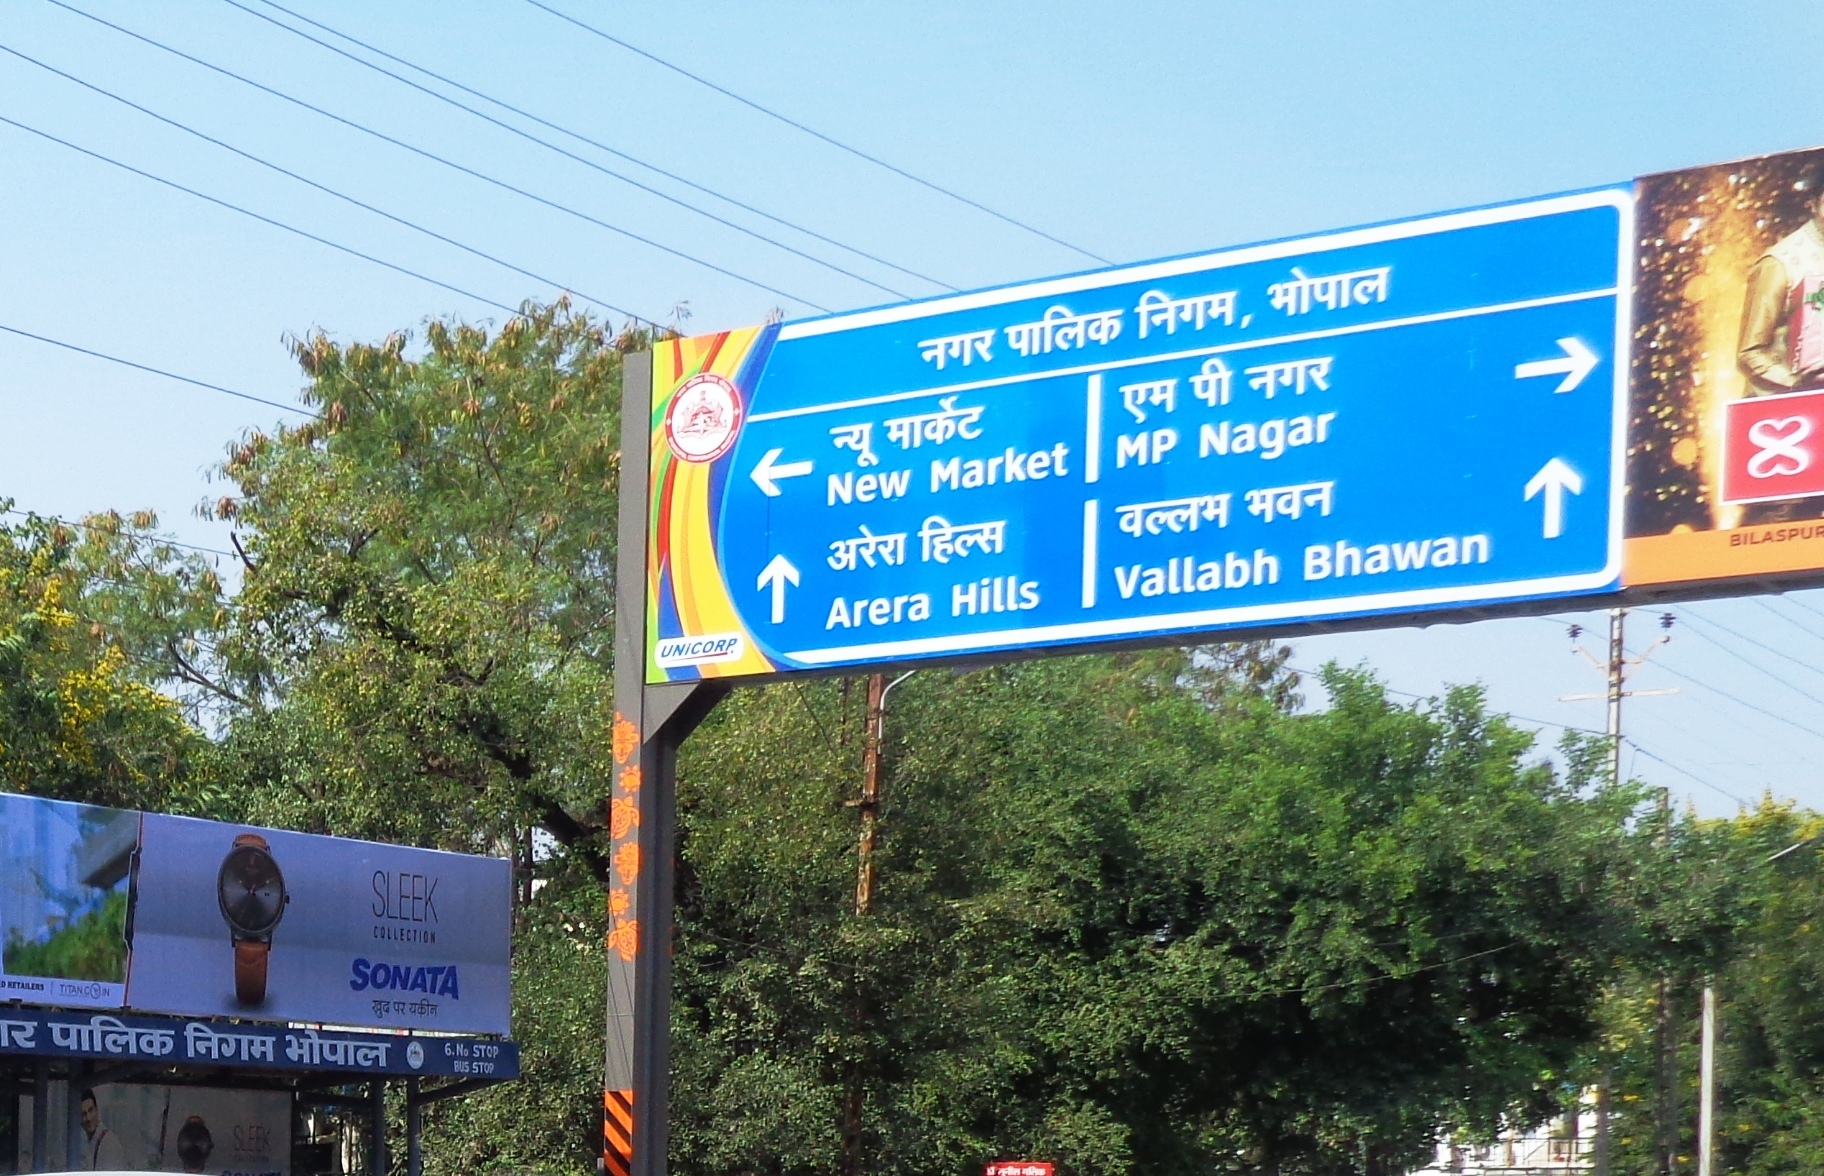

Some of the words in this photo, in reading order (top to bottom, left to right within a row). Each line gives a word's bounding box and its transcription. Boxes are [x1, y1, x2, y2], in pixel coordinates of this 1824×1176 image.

[918, 329, 996, 370] नगर
[1005, 305, 1123, 357] पालिक
[1135, 290, 1252, 339] निगम,
[1267, 267, 1392, 316] भोपाल
[1119, 379, 1176, 423] एम
[1189, 358, 1232, 407] पी
[1244, 356, 1333, 399] नगर
[829, 422, 879, 467] न्यू
[883, 395, 985, 449] मार्केट
[1116, 428, 1177, 468] MP
[1199, 412, 1336, 459] Nagar
[827, 469, 911, 506] New
[931, 442, 1069, 492] Market
[1115, 492, 1231, 538] वल्लभ
[1245, 480, 1334, 523] भवन
[827, 524, 907, 571] अरेरा
[918, 515, 1008, 563] हिल्स
[1114, 548, 1278, 600] Vallabh
[1303, 533, 1490, 581] Bhawan
[825, 592, 931, 630] Arera
[952, 574, 1040, 617] Hills
[372, 870, 439, 923] SLEEK
[373, 926, 436, 944] COLLECTION
[7, 981, 44, 991] RETAILERS
[349, 957, 459, 1000] SONATA
[371, 999, 391, 1019] खुद
[393, 1001, 405, 1016] पर
[47, 1014, 175, 1057] पालिक
[183, 1022, 276, 1062] निगम
[285, 1028, 391, 1068] भोपाल
[453, 1060, 470, 1072] BUS
[472, 1061, 494, 1074] STOP
[472, 1044, 499, 1059] STOP
